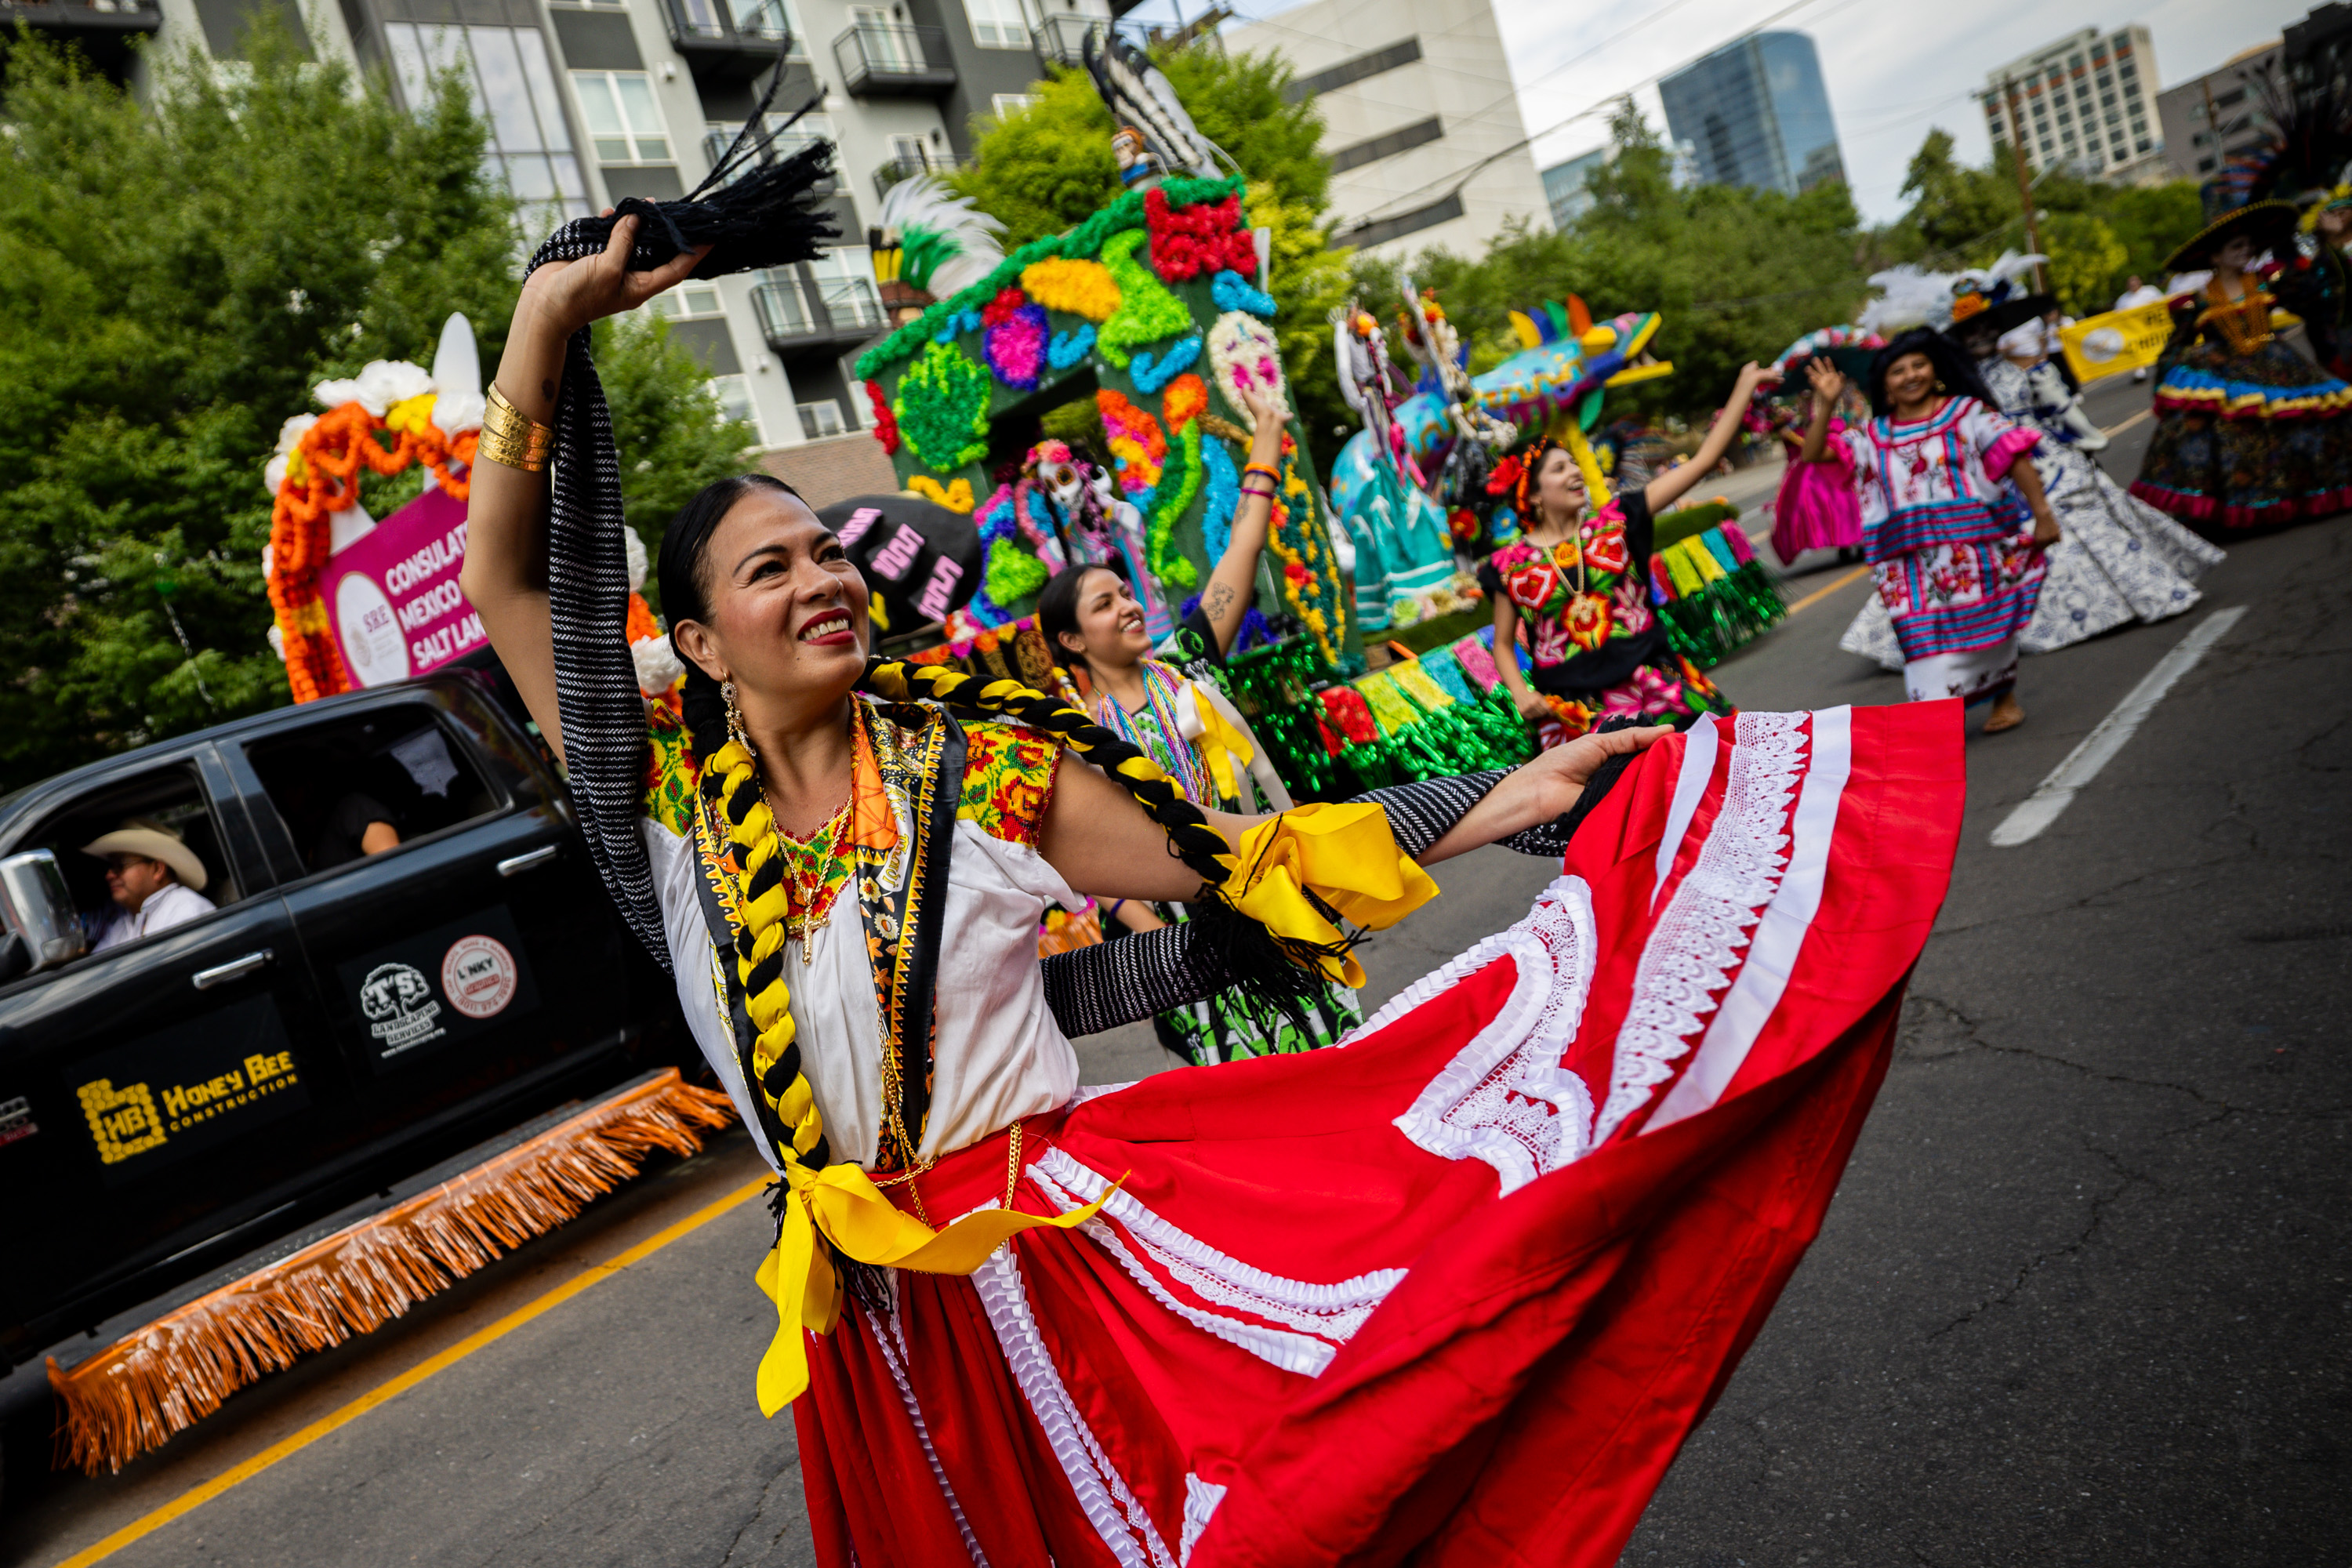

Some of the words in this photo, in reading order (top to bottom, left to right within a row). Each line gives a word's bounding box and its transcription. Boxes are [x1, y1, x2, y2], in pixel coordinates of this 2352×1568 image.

[385, 521, 468, 596] CONSULAT
[397, 579, 463, 633] MEXICO
[412, 627, 452, 670] SALT
[450, 611, 487, 651] LAK
[373, 1003, 437, 1034] LANDSCAPING
[387, 1020, 431, 1043] SERVICES
[161, 1069, 245, 1119] HONEY
[243, 1050, 295, 1087] BEE
[169, 1073, 299, 1133] CONSTRUCTION
[103, 1104, 147, 1142] HB
